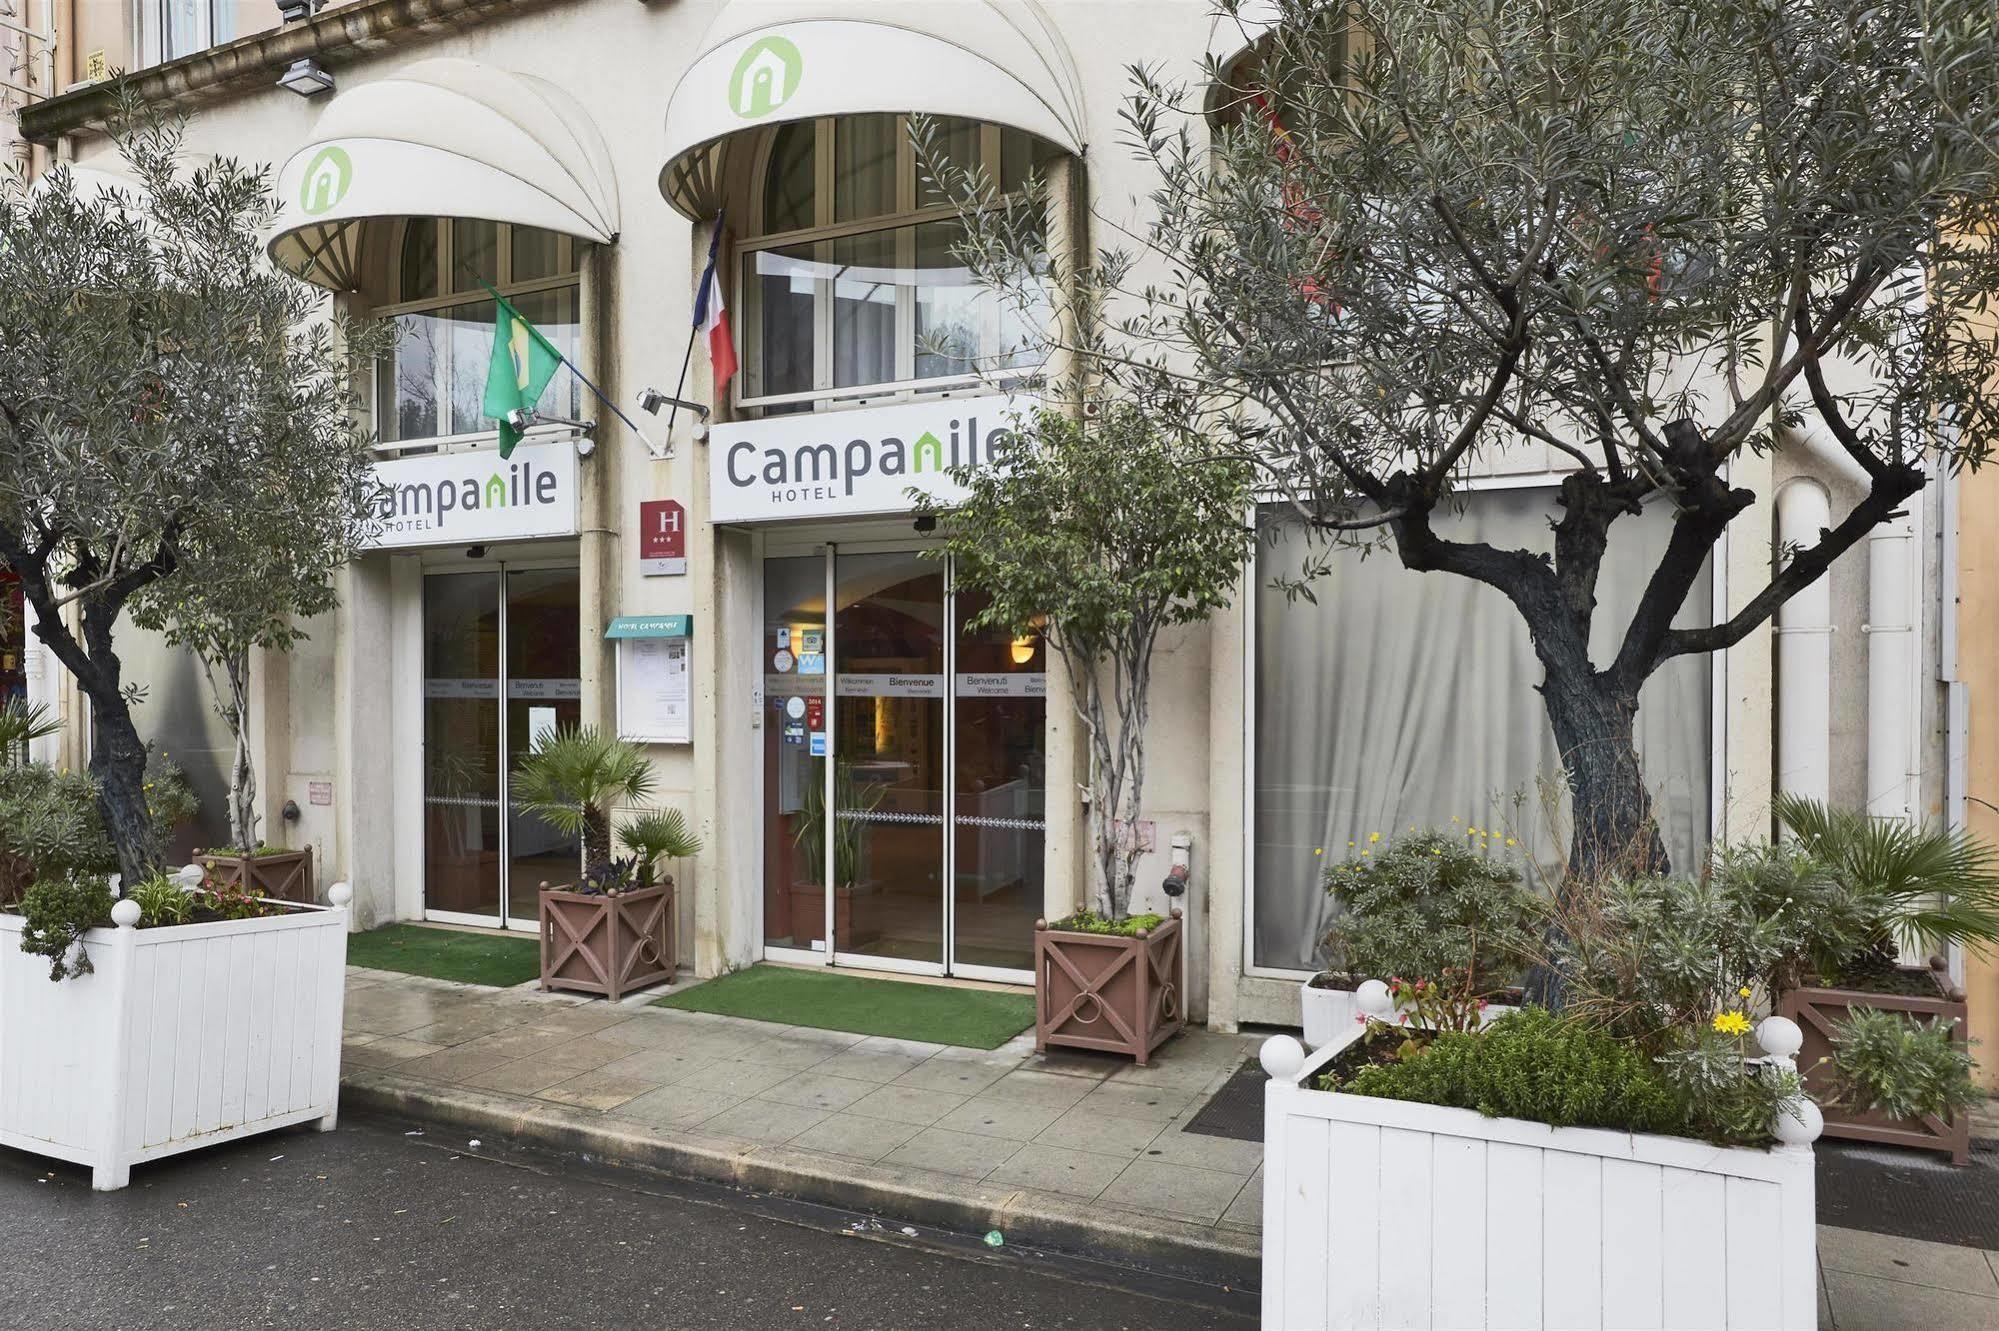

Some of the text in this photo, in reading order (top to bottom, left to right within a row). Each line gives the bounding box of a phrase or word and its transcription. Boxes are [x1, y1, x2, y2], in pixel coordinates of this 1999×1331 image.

[727, 416, 1016, 497] Campanile
[771, 486, 837, 503] HOTEL
[385, 519, 432, 533] HOTEL
[658, 510, 681, 533] H
[888, 676, 935, 687] Bienvenue
[977, 687, 1009, 695] Welcome
